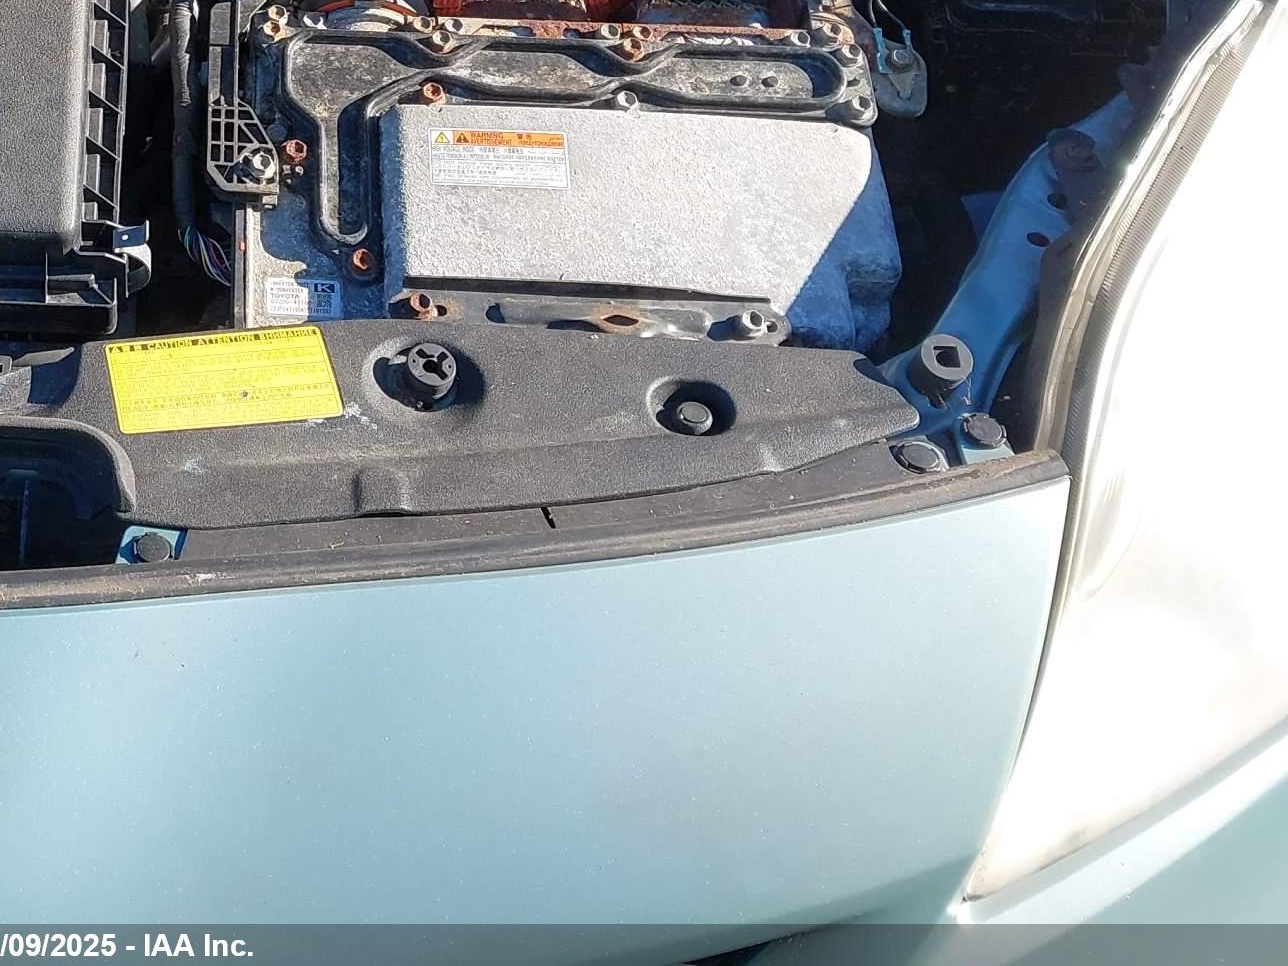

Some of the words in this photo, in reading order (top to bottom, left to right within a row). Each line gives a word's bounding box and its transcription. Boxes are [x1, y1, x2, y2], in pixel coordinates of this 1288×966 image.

[470, 131, 504, 139] WARNING
[147, 339, 193, 351] CAUTION
[197, 333, 256, 347] ATTENTION
[260, 329, 317, 342] ВНИМАНИЕ
